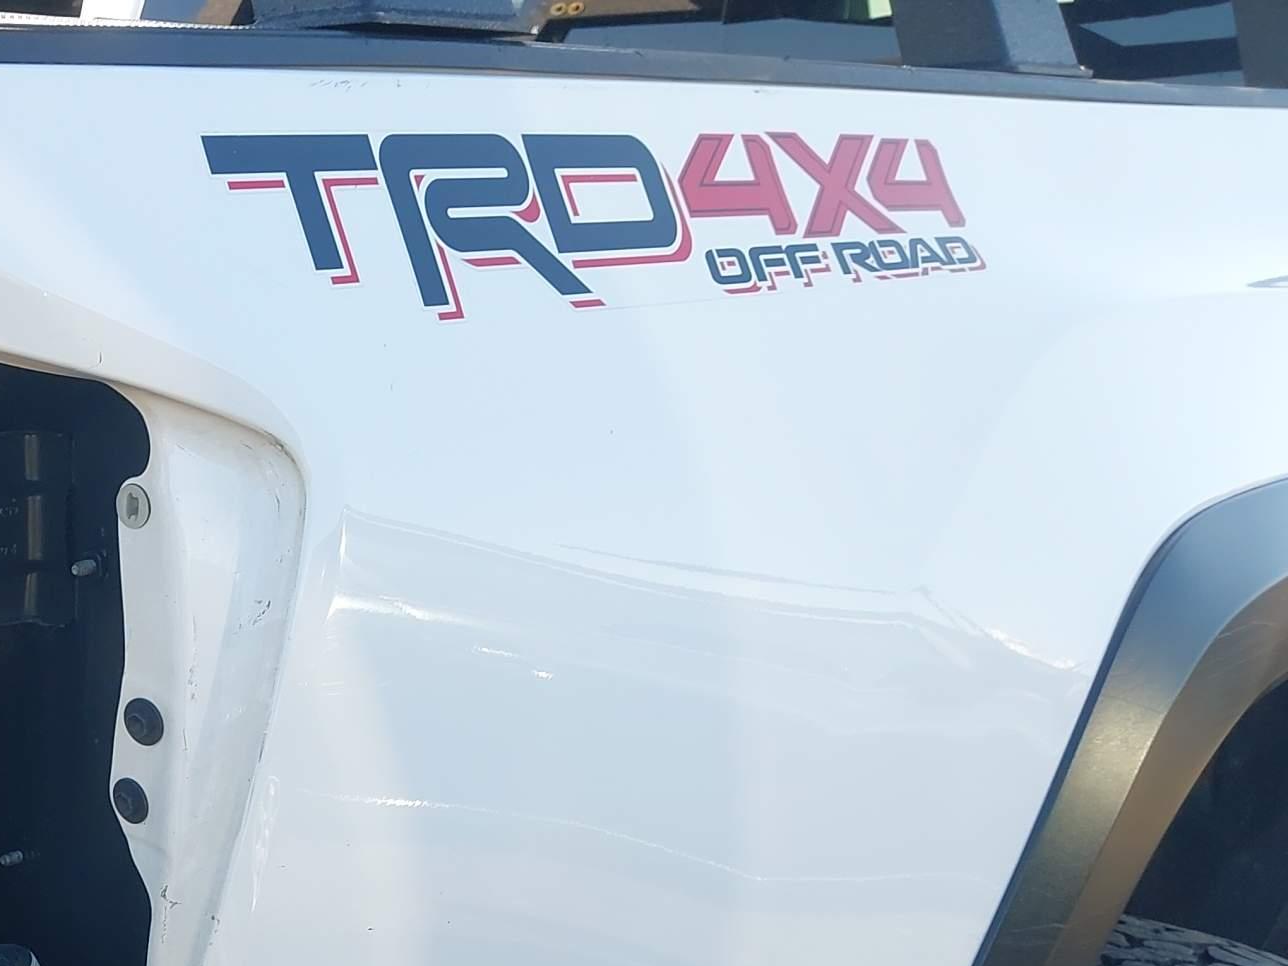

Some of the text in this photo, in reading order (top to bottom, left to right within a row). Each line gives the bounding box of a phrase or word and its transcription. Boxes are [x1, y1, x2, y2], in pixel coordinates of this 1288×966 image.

[201, 133, 690, 320] TRD
[705, 236, 986, 294] OFF ROAD
